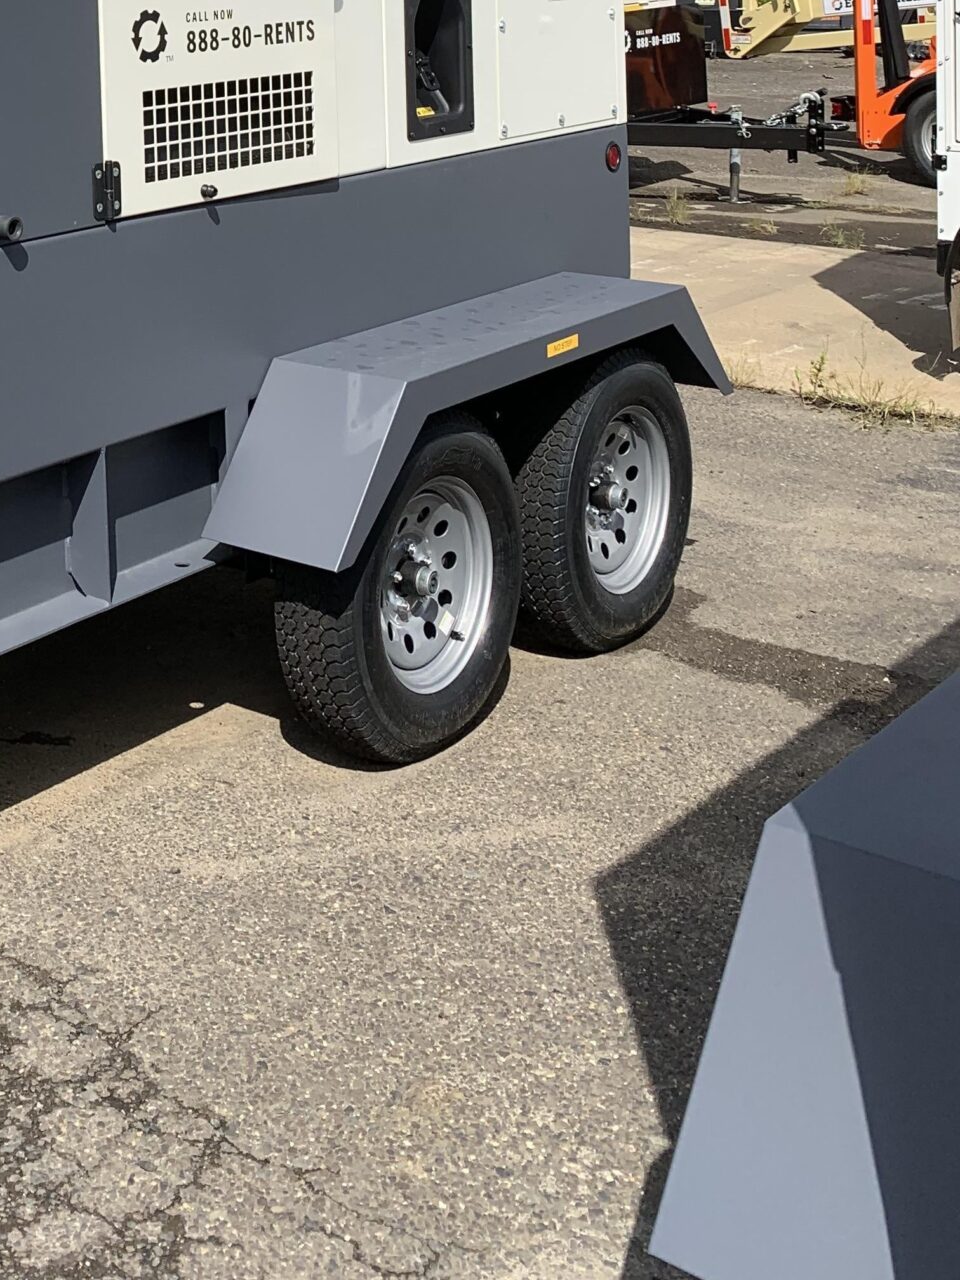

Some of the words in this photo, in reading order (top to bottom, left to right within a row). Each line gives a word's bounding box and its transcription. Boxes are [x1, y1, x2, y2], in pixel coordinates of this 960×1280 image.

[185, 11, 209, 23] CALL
[213, 9, 234, 21] NOW
[186, 19, 316, 54] 888-80-RENTS
[636, 32, 681, 49] 888-80-RENTS
